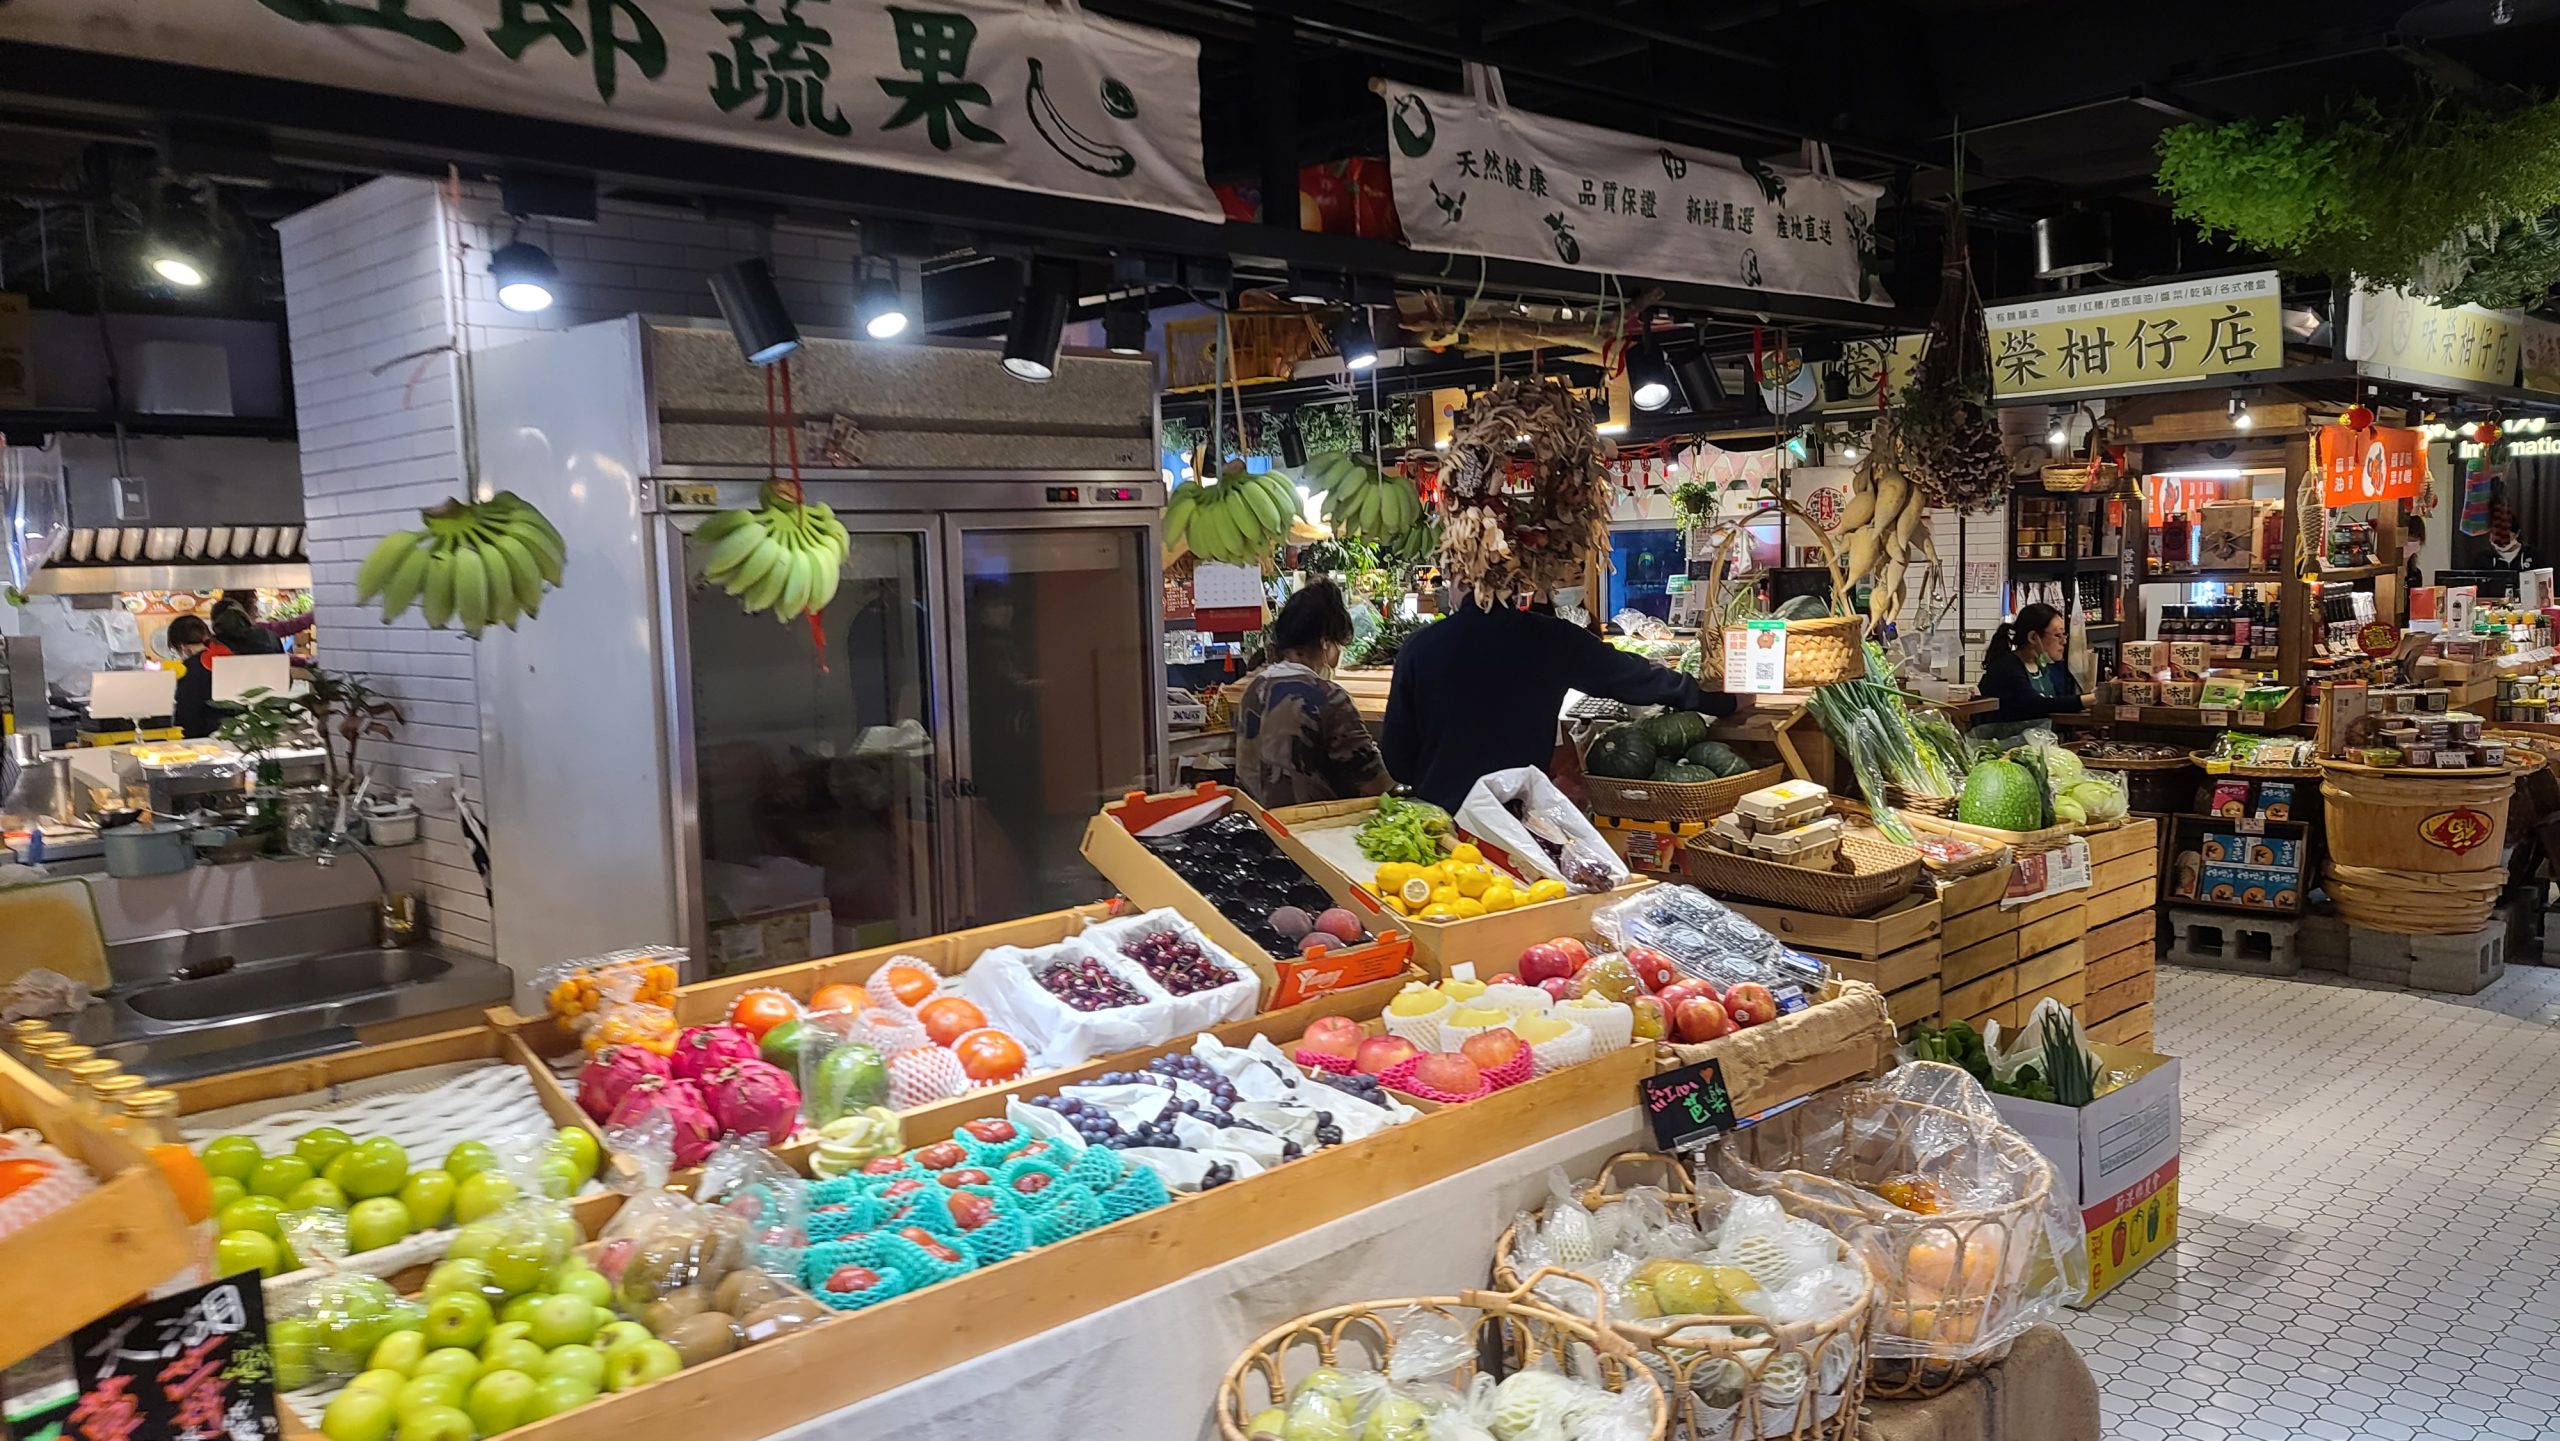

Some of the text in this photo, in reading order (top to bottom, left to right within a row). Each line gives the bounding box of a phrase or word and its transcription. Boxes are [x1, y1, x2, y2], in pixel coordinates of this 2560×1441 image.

[1456, 150, 1833, 246] 天然健康 品質保證 新鮮嚴選 產地直送
[1996, 304, 2260, 387] 榮柑仔店
[2127, 646, 2152, 658] 味噌
[2175, 646, 2200, 658] 味噌
[2127, 685, 2152, 697] 味噌
[2166, 686, 2191, 698] 味噌
